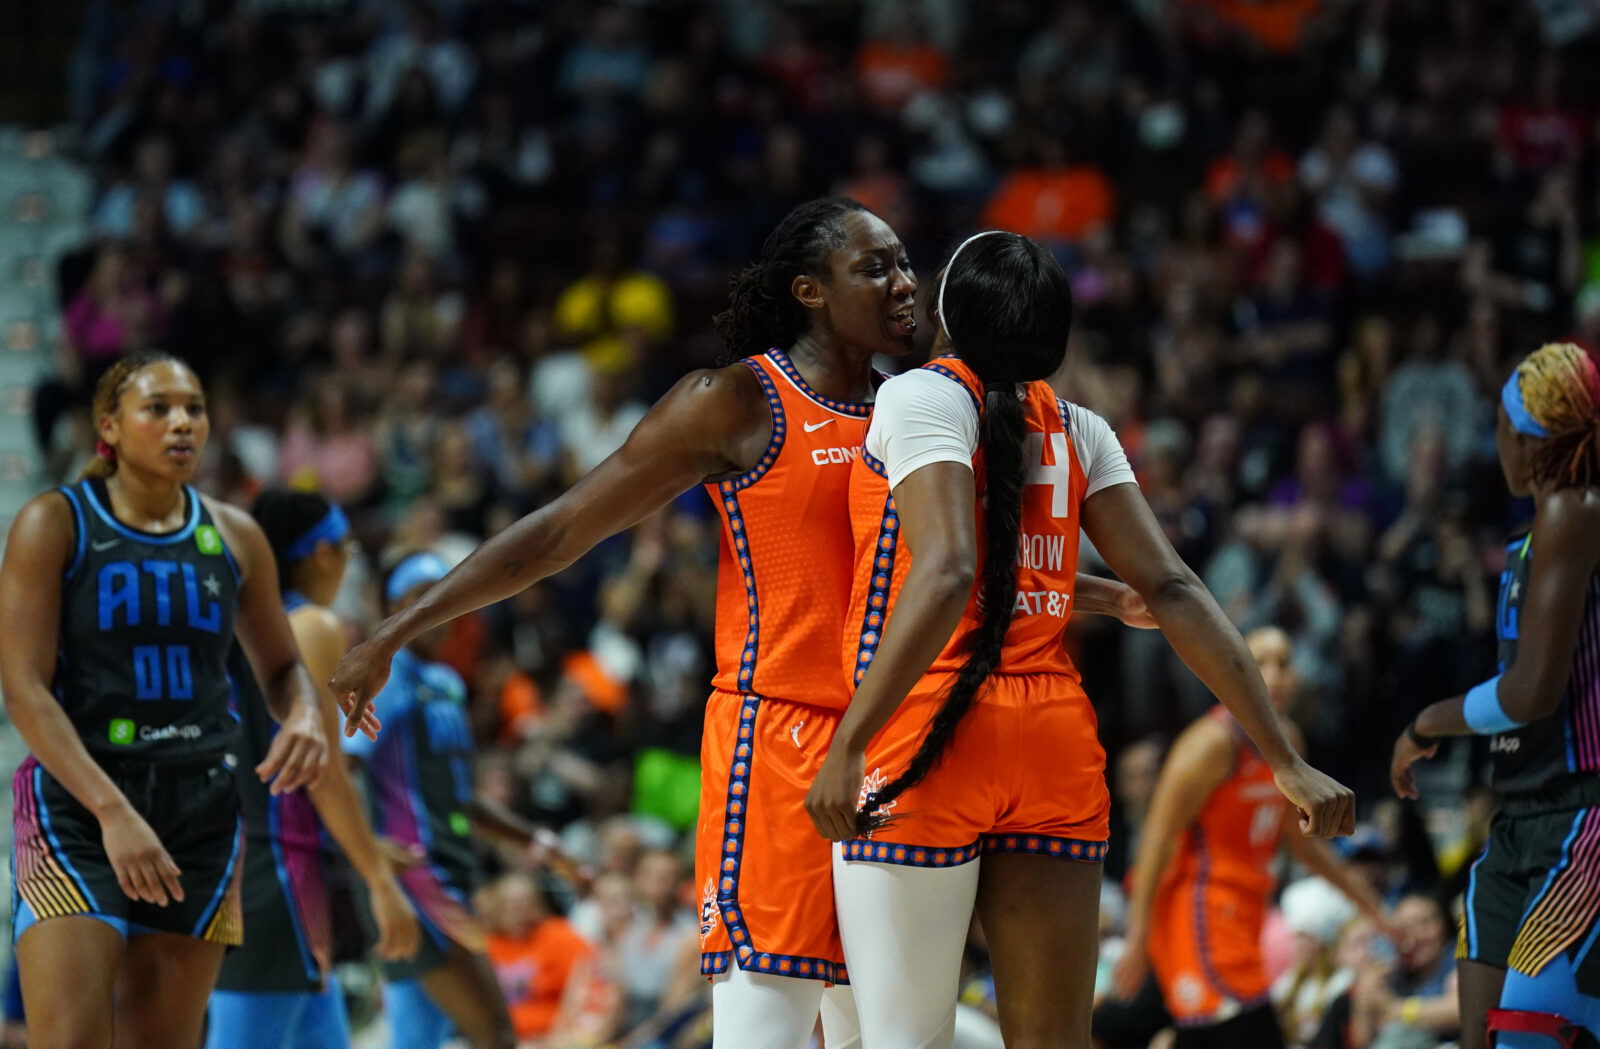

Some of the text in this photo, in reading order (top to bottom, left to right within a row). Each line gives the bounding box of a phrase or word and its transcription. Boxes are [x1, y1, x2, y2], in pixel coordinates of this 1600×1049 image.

[811, 446, 861, 466] CON
[97, 560, 222, 634] ATL
[1012, 590, 1070, 619] AT&T
[133, 645, 193, 700] 00
